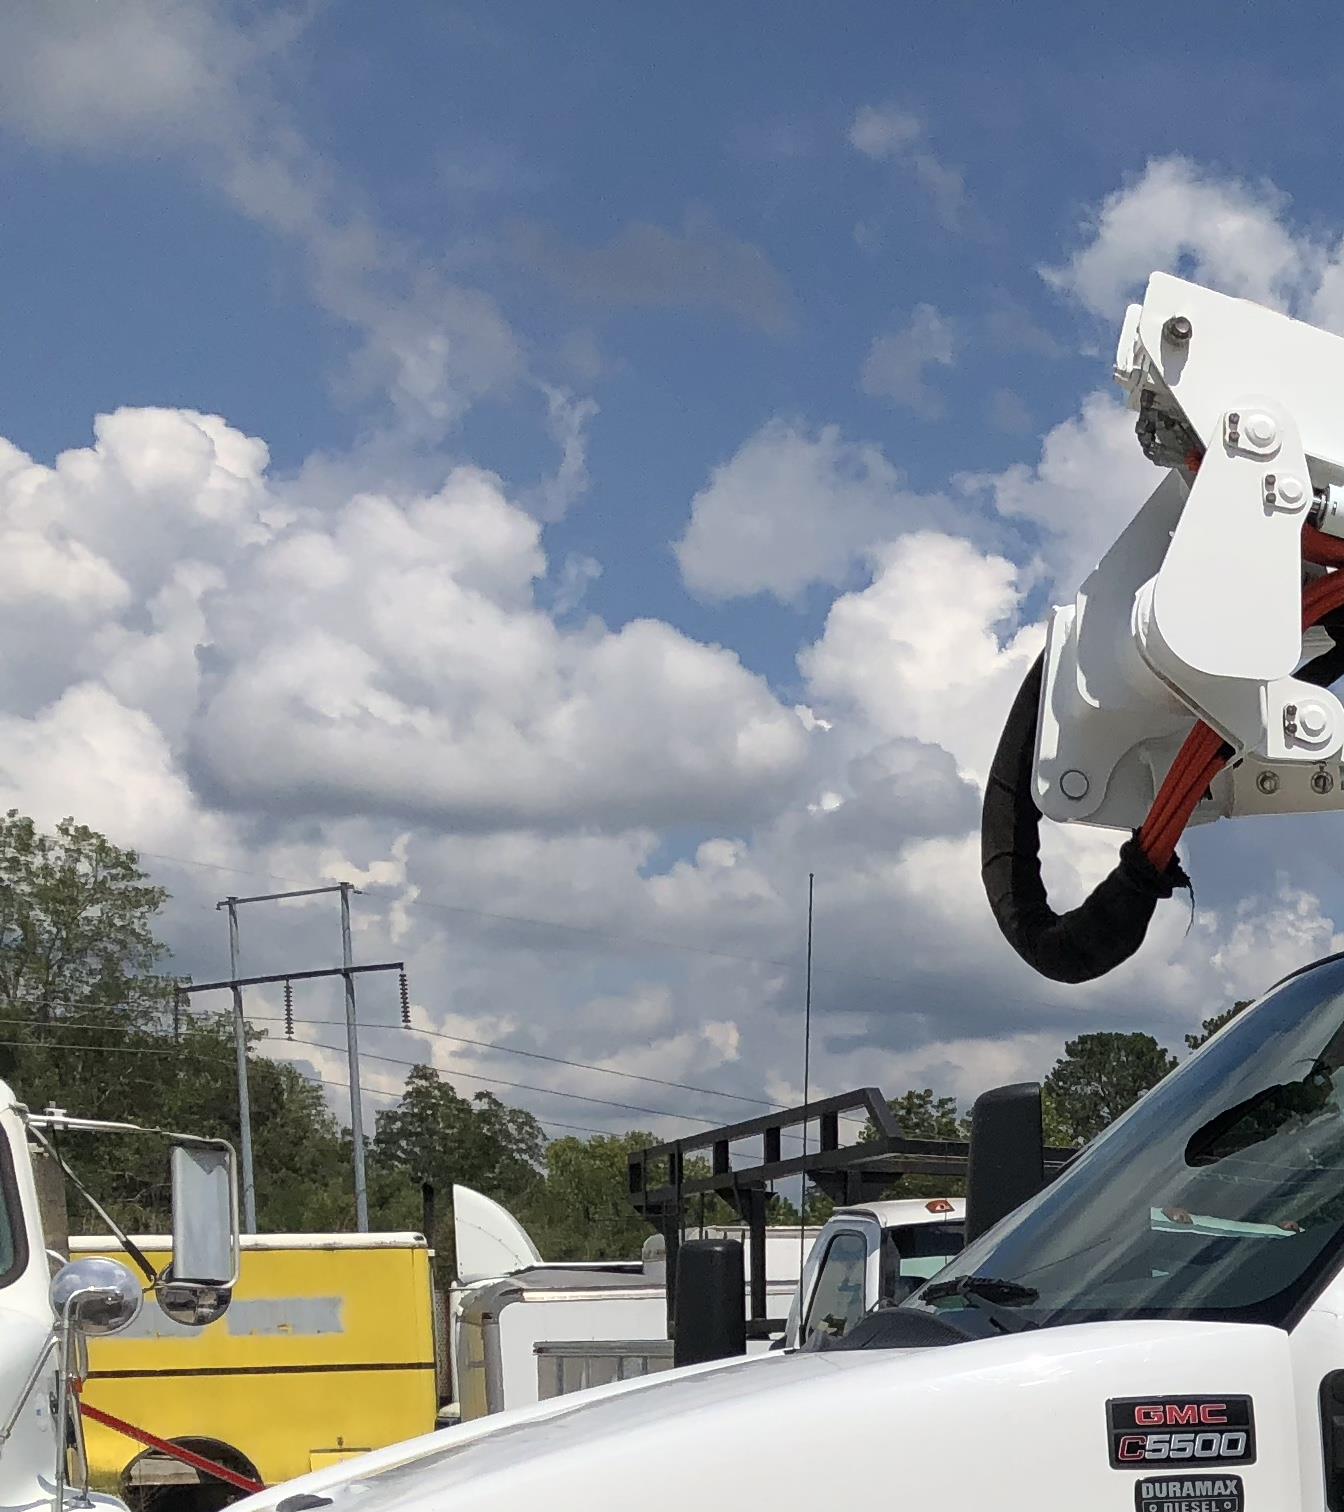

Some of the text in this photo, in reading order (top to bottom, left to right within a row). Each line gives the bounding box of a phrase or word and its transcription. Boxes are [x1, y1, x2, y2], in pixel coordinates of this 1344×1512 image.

[1134, 1403, 1228, 1426] GMC
[1118, 1432, 1247, 1461] C5500
[1141, 1479, 1238, 1499] DURAMAX
